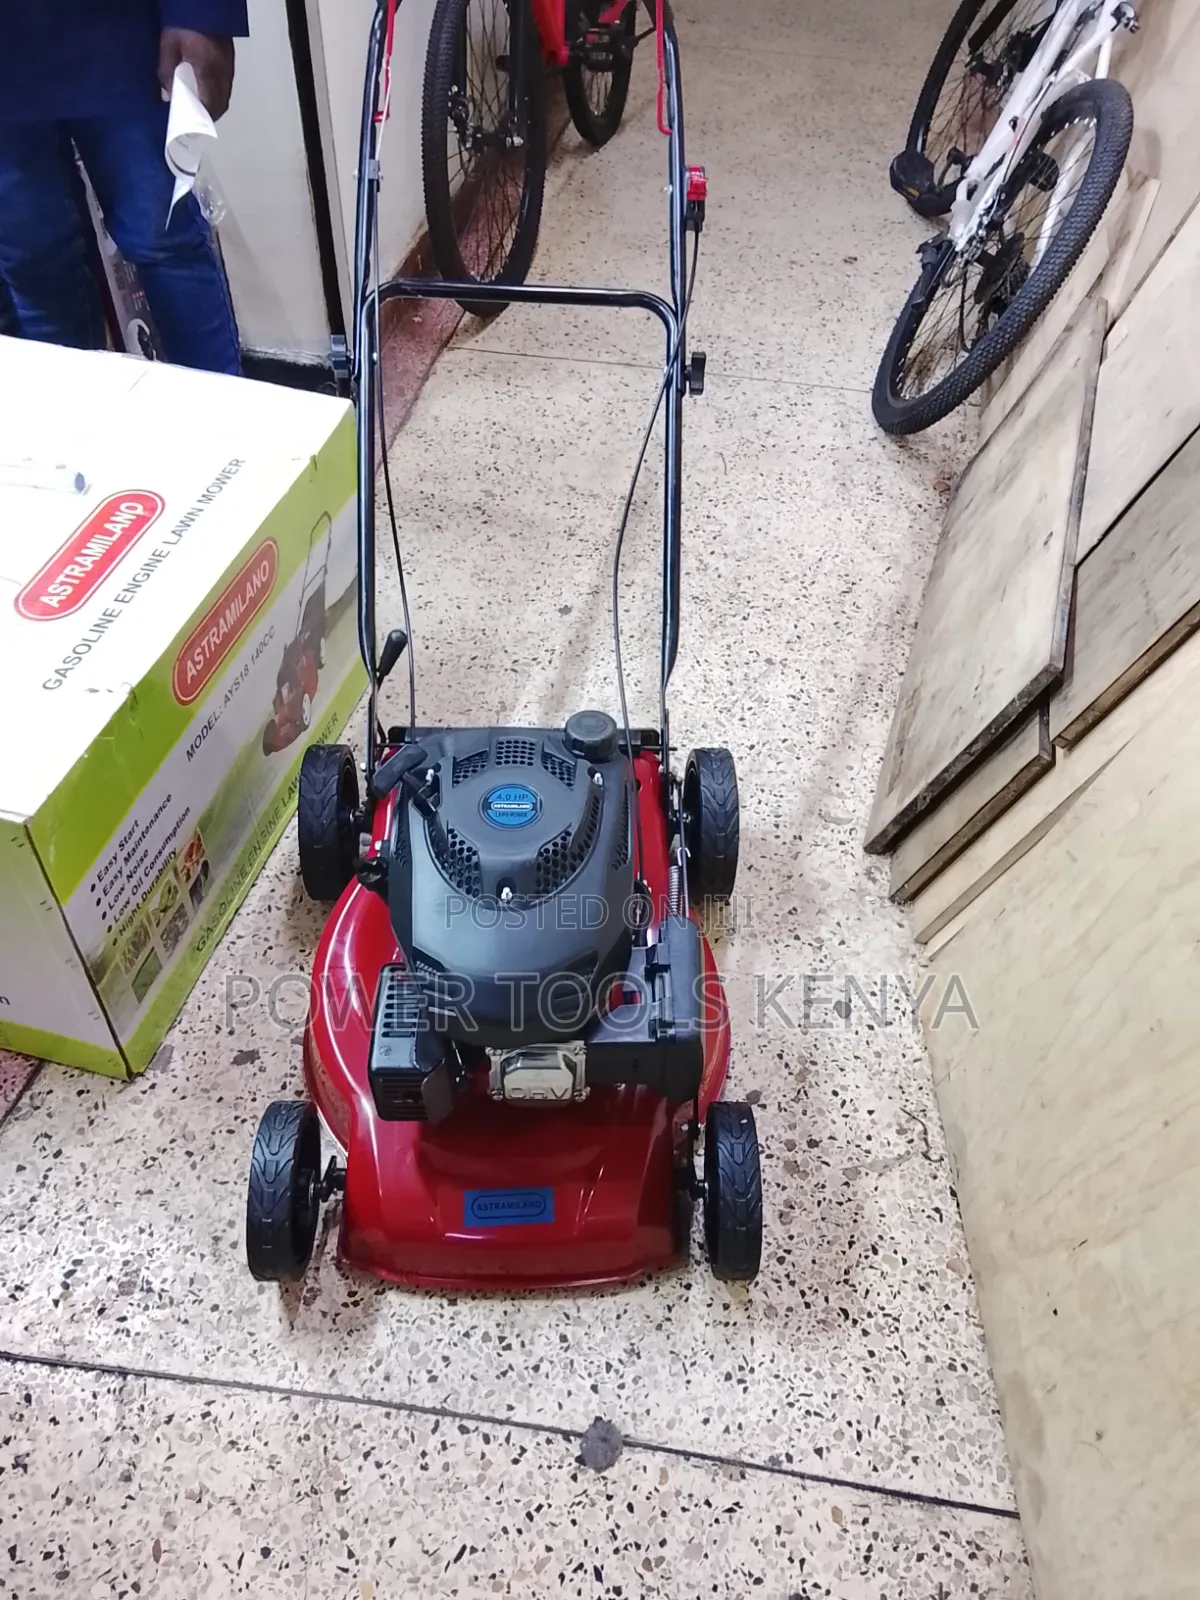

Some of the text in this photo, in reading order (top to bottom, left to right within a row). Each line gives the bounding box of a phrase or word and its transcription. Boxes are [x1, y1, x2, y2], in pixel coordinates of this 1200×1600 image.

[39, 501, 144, 608] ASTRAMILANO
[42, 457, 247, 691] GASOLINE ENGINE LAWN MOWER
[185, 559, 270, 685] ASTRAMILANO
[185, 625, 276, 763] MODEL: AYS18 140CC
[102, 793, 172, 897] Easy Maintenance
[496, 793, 529, 801] 4.0 HP
[96, 819, 140, 884] Easy Start
[107, 848, 150, 911] Low Noise
[113, 806, 191, 924] Low Oil Consumption
[118, 848, 178, 937] Hight Durability
[195, 867, 248, 953] GASOLINE
[477, 1200, 541, 1212] ASTRAMILANO
